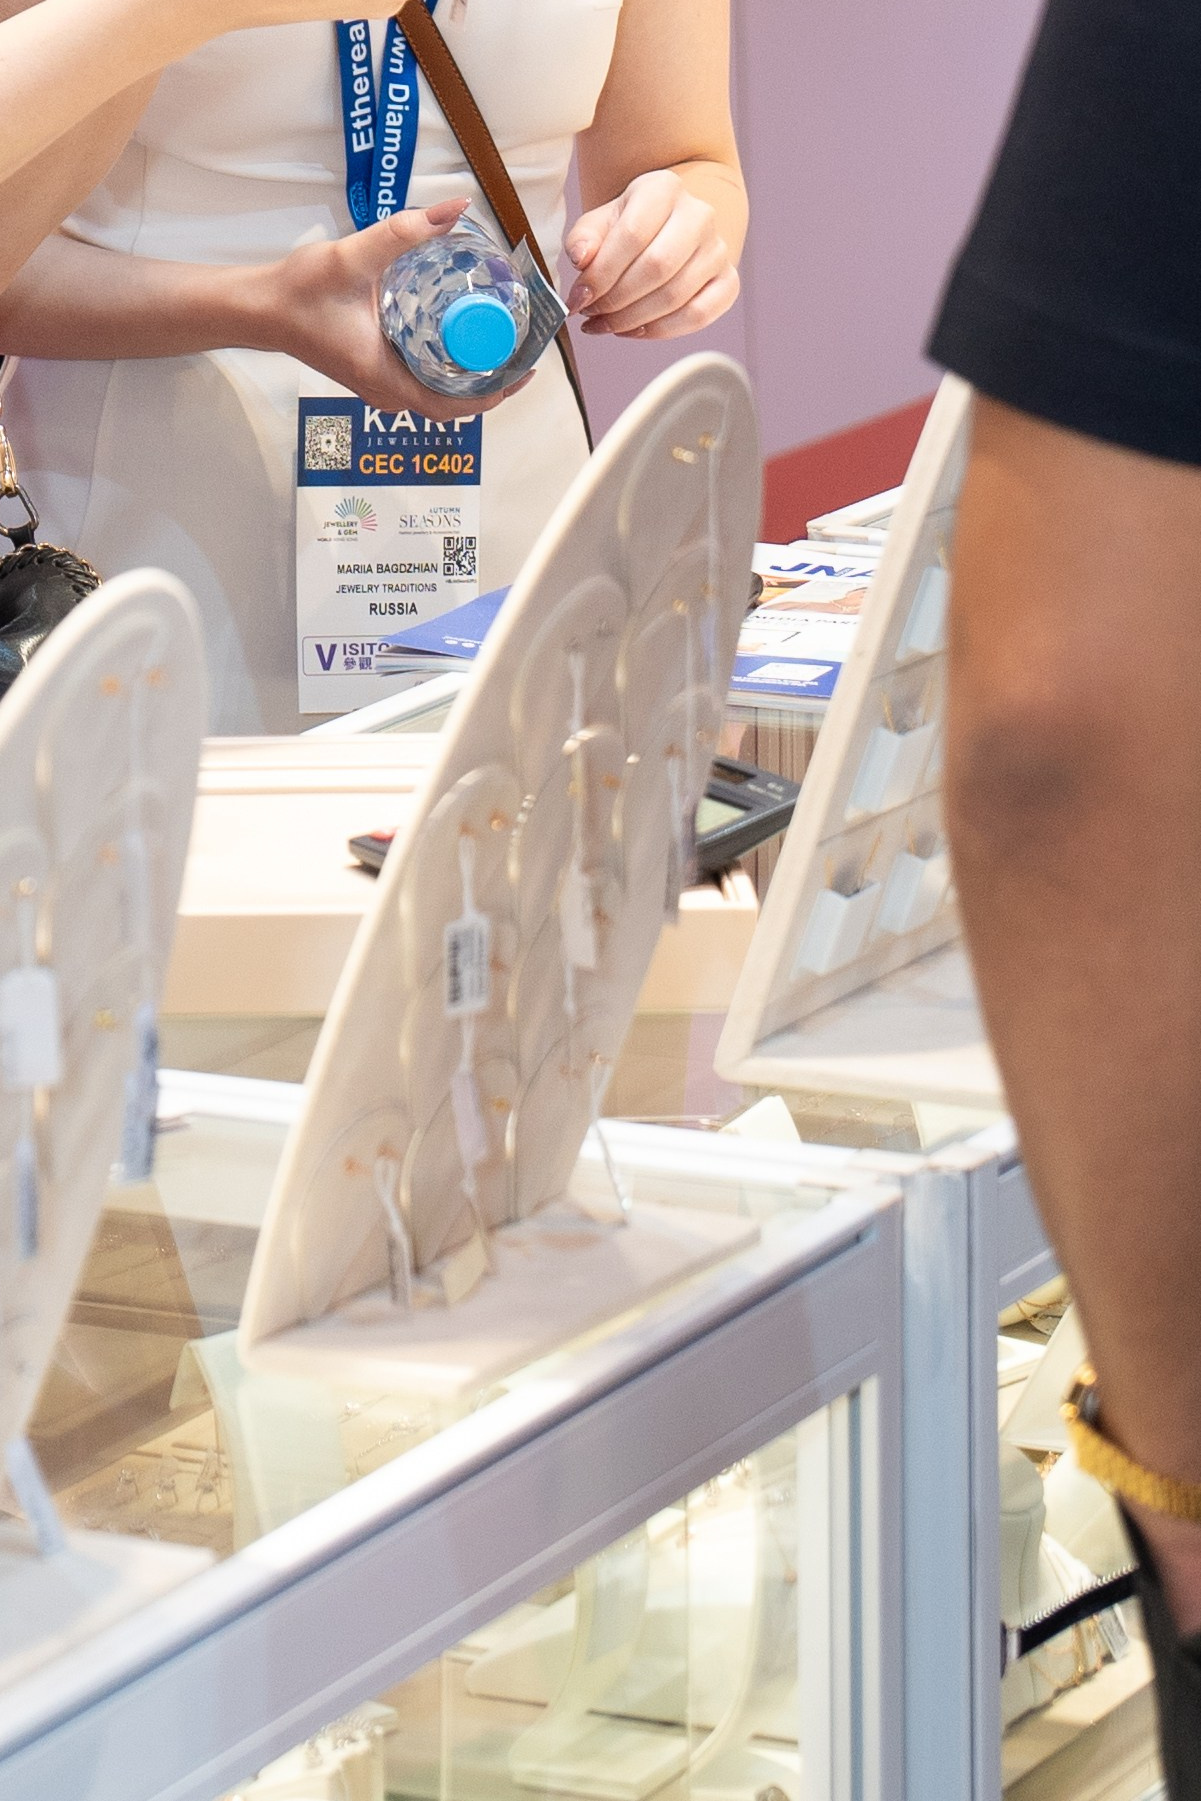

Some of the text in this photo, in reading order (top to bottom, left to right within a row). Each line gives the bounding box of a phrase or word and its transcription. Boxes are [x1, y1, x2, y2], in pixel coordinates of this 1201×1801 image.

[376, 82, 410, 221] Diamonds
[367, 436, 465, 448] JEWELLERY
[358, 453, 475, 475] CEC 1C402
[430, 506, 461, 514] AUTUMN
[323, 520, 358, 530] JEWELLERY
[399, 514, 462, 529] SEASONS
[336, 562, 439, 574] MARIIA BAGDZHIAN
[335, 582, 438, 595] JEWELRY TRADITIONS
[368, 602, 419, 616] RUSSIA
